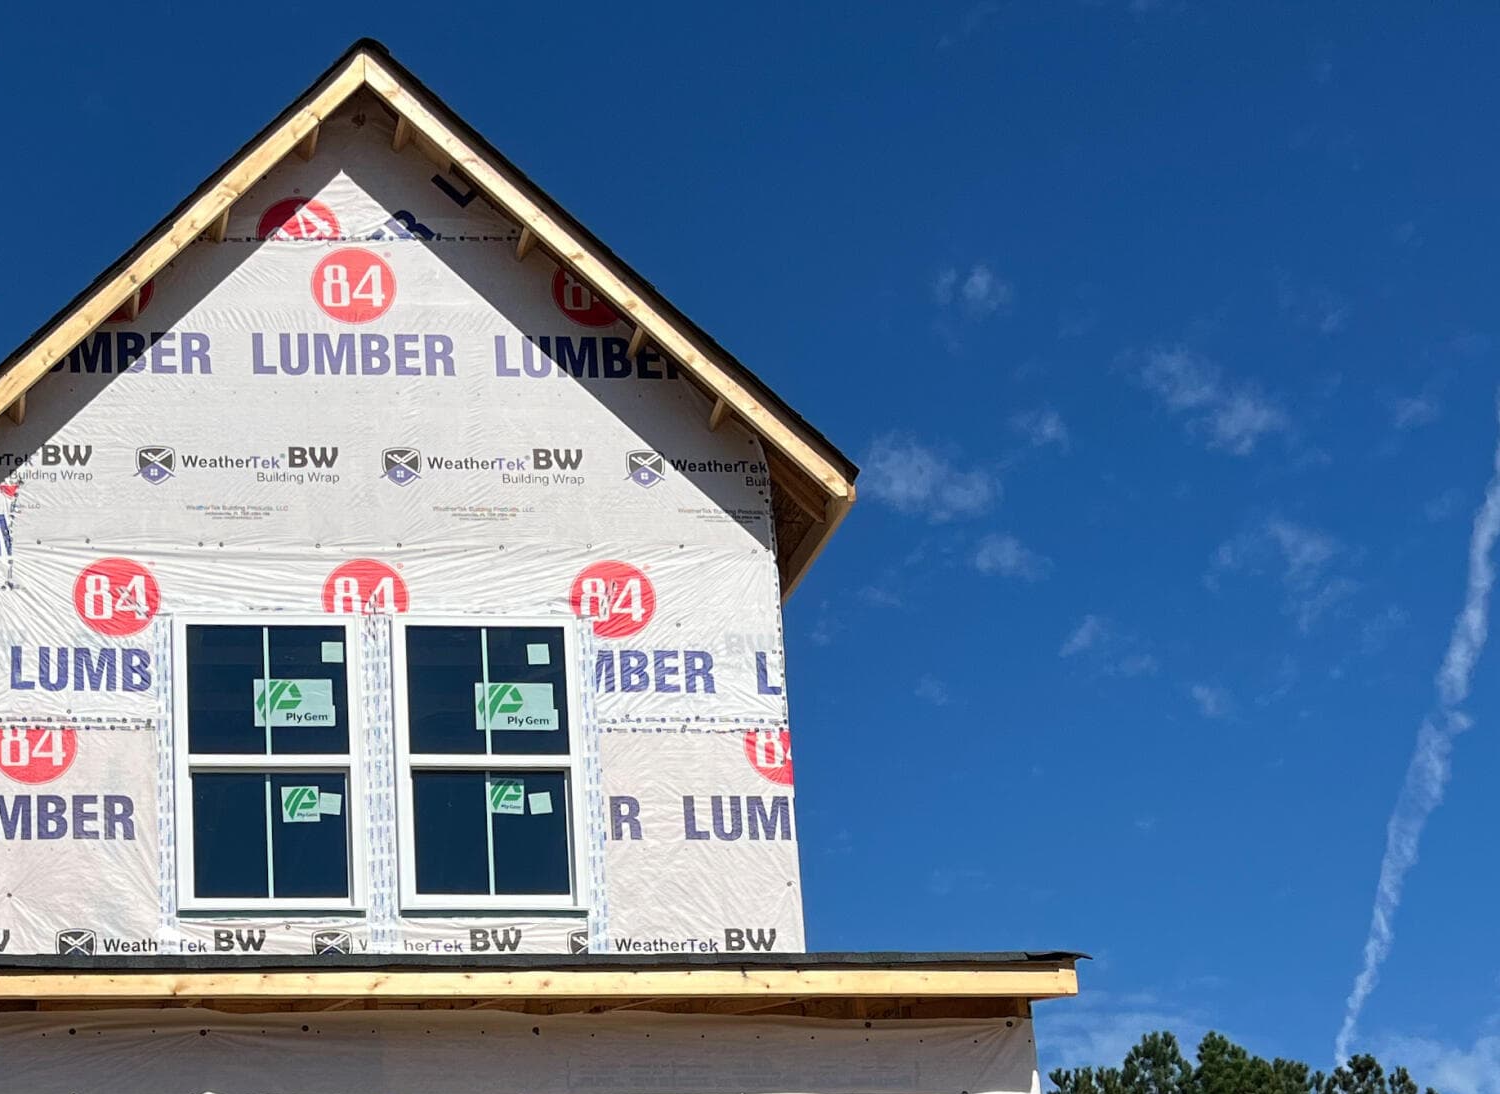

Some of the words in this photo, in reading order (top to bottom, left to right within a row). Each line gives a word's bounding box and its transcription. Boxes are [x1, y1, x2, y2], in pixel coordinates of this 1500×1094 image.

[322, 264, 386, 307] 84
[251, 332, 456, 378] LUMBER
[494, 335, 682, 380] LUMBE
[41, 445, 93, 466] BW
[182, 454, 281, 469] WeatherTek
[288, 447, 339, 468] BW
[428, 456, 524, 471] WeatherTek
[533, 448, 583, 470] BW
[671, 459, 767, 473] WeatherTek
[10, 470, 57, 483] Building
[60, 470, 93, 482] Wrap
[257, 471, 304, 484] Building
[308, 471, 340, 483] Wrap
[502, 473, 549, 486] Building
[552, 474, 585, 486] Wrap
[84, 575, 149, 620] 84
[580, 578, 645, 622] 84
[10, 646, 151, 692] LUMB
[286, 712, 302, 723] Ply
[304, 712, 328, 721] Gem
[507, 716, 524, 727] Ply
[525, 716, 550, 725] Gem
[0, 729, 67, 767] 84
[682, 795, 792, 841] LUM
[214, 929, 266, 952] BW
[470, 928, 522, 952] BW
[615, 938, 719, 952] WeatherTek
[724, 928, 777, 952] BW
